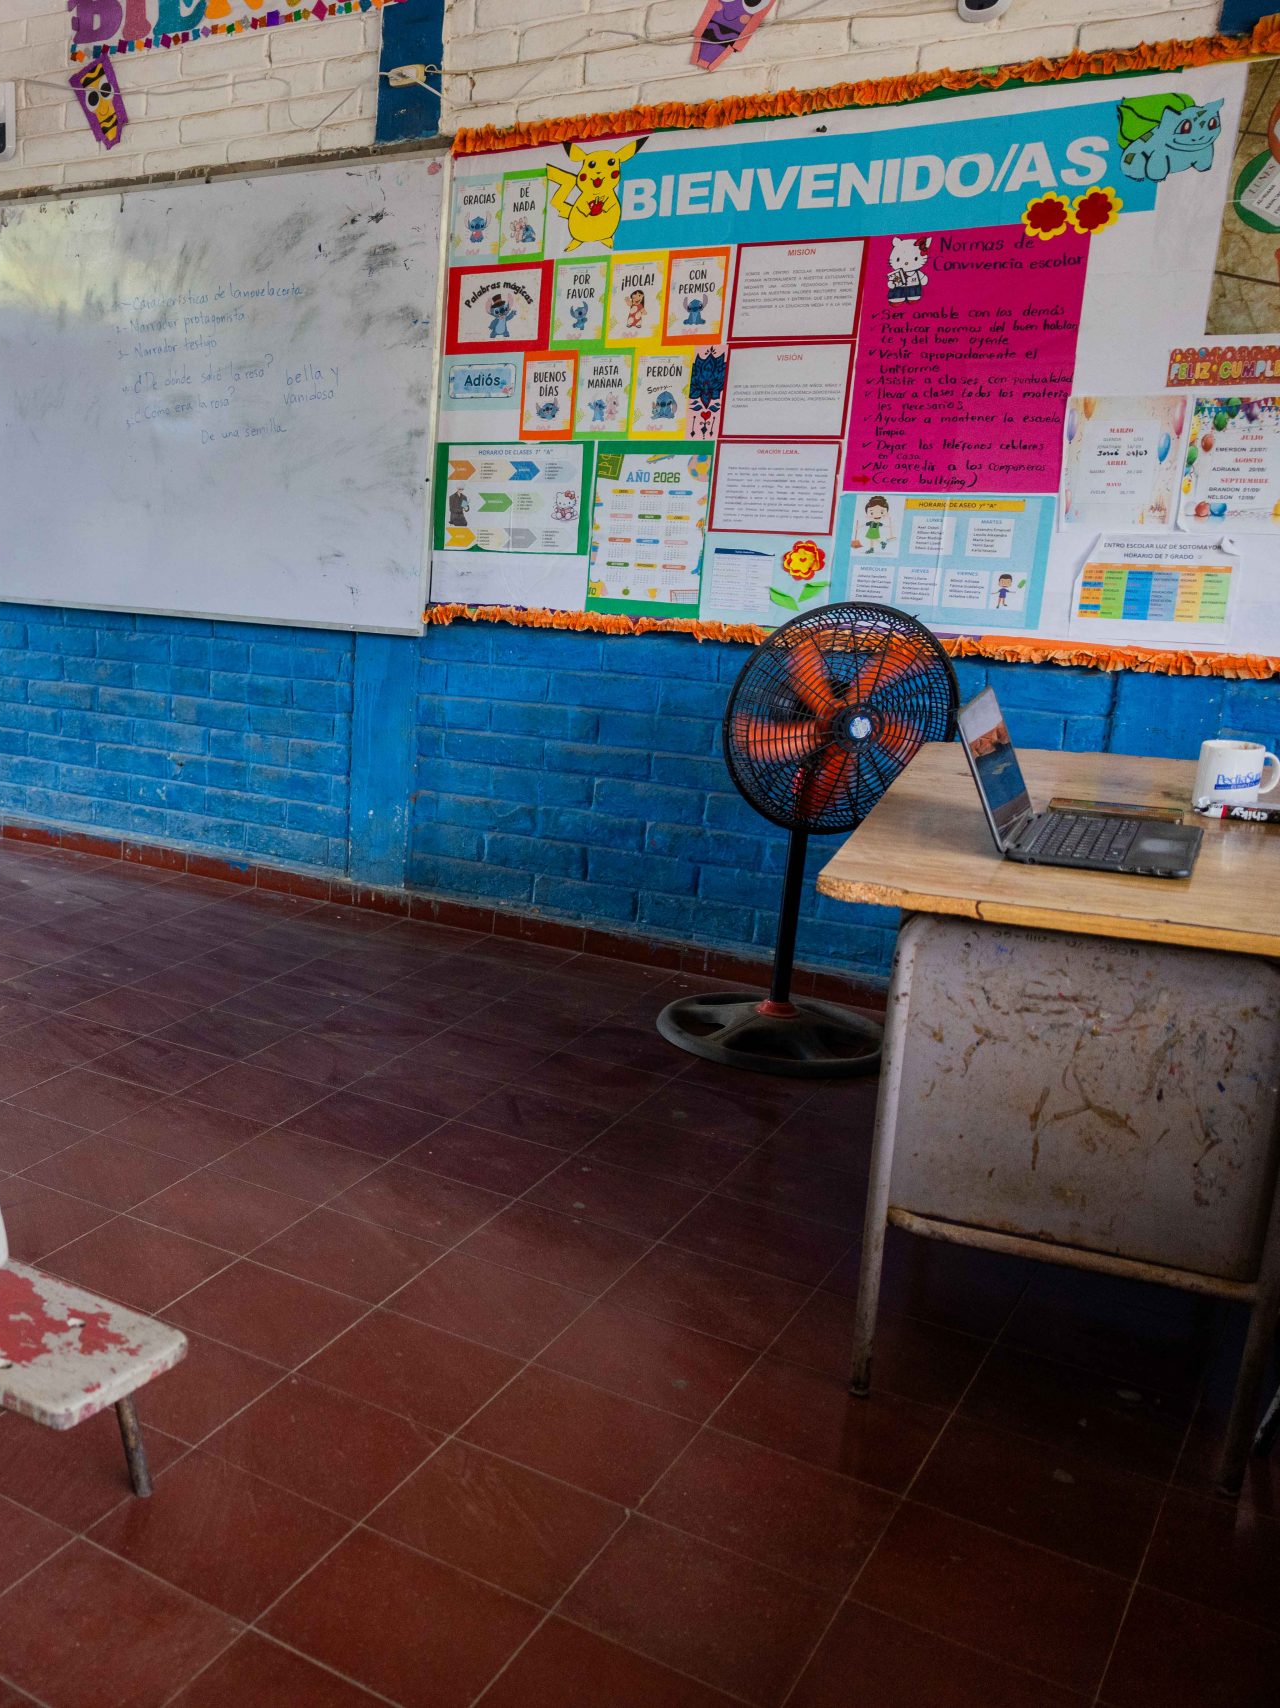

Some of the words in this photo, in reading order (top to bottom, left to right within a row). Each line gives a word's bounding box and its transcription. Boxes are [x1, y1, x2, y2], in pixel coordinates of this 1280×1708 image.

[620, 136, 1110, 221] BIENVENIDO/AS
[520, 187, 530, 198] DE
[463, 193, 496, 206] GRACIAS
[513, 200, 536, 212] NADA
[940, 236, 1005, 253] Normas
[1014, 234, 1035, 249] de
[933, 255, 1024, 272] Convivencia
[1029, 254, 1085, 269] escolar
[573, 274, 591, 285] POR
[689, 269, 707, 281] CON
[621, 273, 655, 291] ¡HOLA!
[678, 282, 716, 294] PERMISO
[214, 285, 225, 299] de
[464, 281, 501, 308] Palabras
[502, 280, 534, 305] mágicas
[567, 287, 595, 299] FAVOR
[881, 309, 905, 320] Ser
[912, 308, 959, 319] amable
[968, 309, 991, 318] con
[996, 306, 1013, 318] los
[1022, 304, 1065, 317] demás
[130, 317, 178, 334] Narrador
[183, 310, 247, 335] protagonista
[881, 323, 931, 334] Practicar
[937, 323, 982, 334] normas
[989, 322, 1005, 333] del
[1012, 320, 1038, 331] buen
[134, 339, 178, 358] Narrador
[184, 334, 218, 357] testigo
[899, 336, 907, 348] y
[911, 333, 929, 345] del
[934, 333, 959, 344] buen
[969, 335, 1009, 349] oyente
[777, 352, 803, 361] VISIÓN
[879, 348, 913, 360] Vestir
[1025, 347, 1038, 360] el
[286, 363, 323, 386] bella
[533, 371, 567, 383] BUENOS
[593, 365, 619, 376] HASTA
[646, 364, 683, 377] PERDÓN
[1170, 362, 1211, 380] FELIZ
[464, 374, 501, 387] Adiós
[587, 376, 623, 389] MAÑANA
[877, 375, 916, 386] Asistir
[924, 377, 932, 386] a
[987, 375, 1007, 384] con
[284, 382, 336, 407] vanidosa
[539, 382, 559, 397] DÍAS
[912, 390, 919, 398] a
[923, 387, 955, 398] clases
[961, 386, 991, 399] todos
[999, 387, 1014, 398] los
[174, 402, 193, 414] era
[877, 401, 892, 411] les
[875, 413, 916, 425] Ayudar
[923, 416, 932, 424] a
[940, 414, 997, 424] mantener
[1003, 413, 1014, 423] la
[1022, 413, 1061, 424] escuela
[201, 429, 215, 444] De
[222, 430, 239, 439] una
[244, 419, 287, 436] semilla
[875, 426, 905, 437] limpia
[876, 440, 908, 454] Dejar
[919, 440, 934, 450] los
[942, 439, 992, 451] teléfonos
[872, 461, 889, 472] No
[948, 463, 956, 471] a
[966, 461, 983, 471] los
[626, 469, 650, 483] AÑO
[653, 472, 680, 483] 2026
[1231, 806, 1268, 821] chiky
